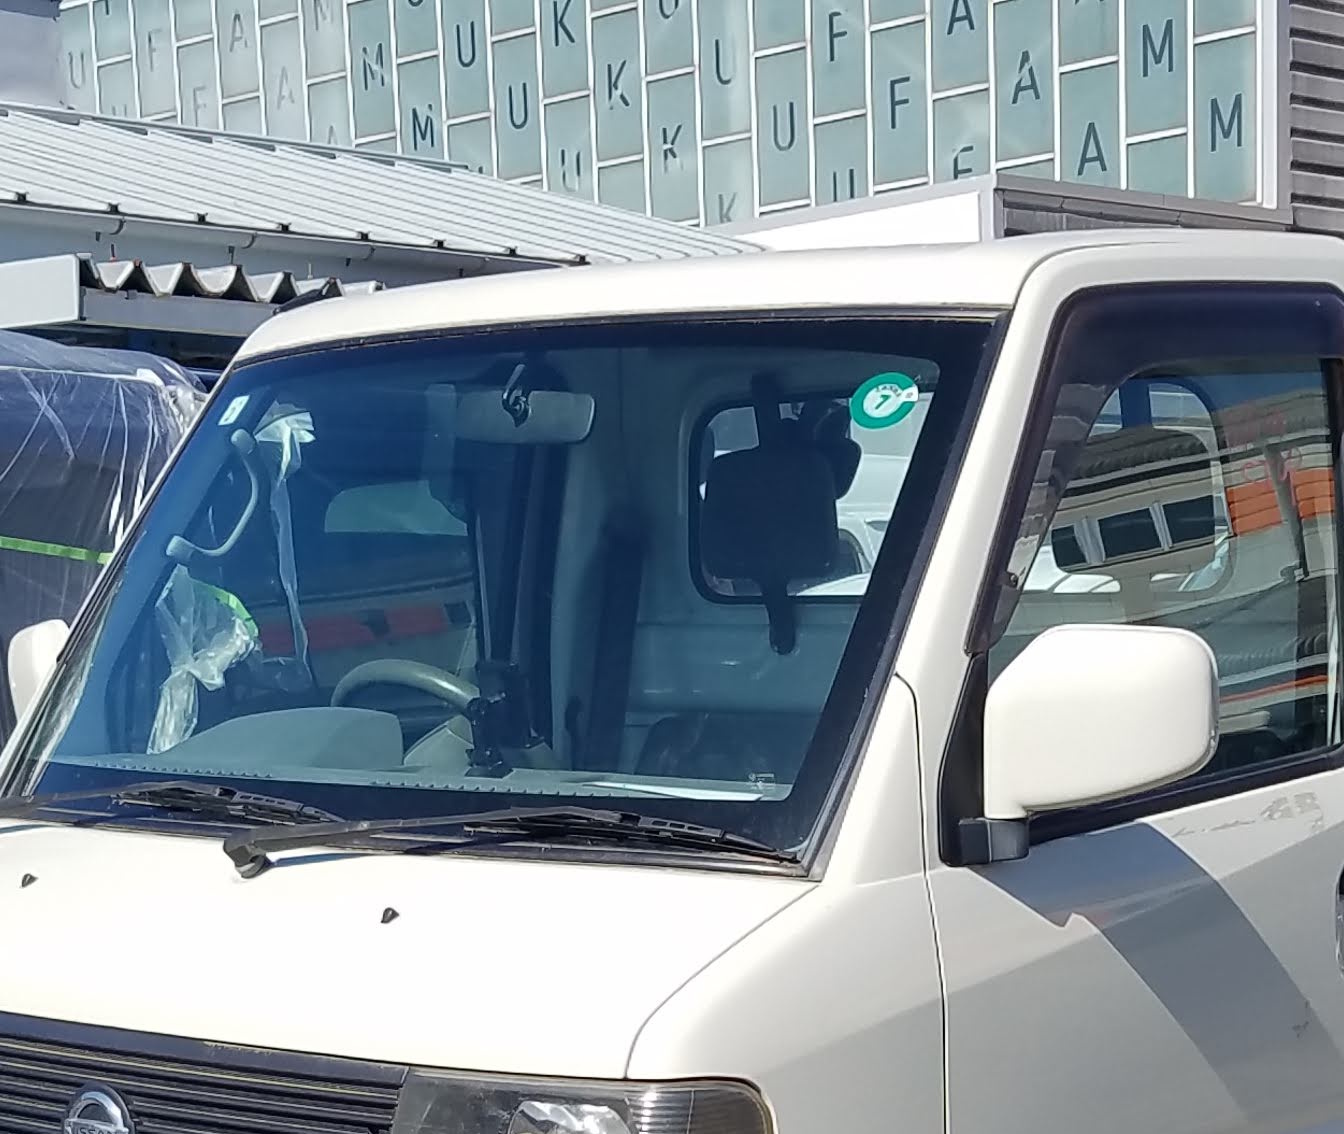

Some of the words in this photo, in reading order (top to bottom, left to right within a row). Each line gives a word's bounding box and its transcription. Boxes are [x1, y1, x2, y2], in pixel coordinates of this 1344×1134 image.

[228, 12, 248, 53] A
[362, 43, 385, 91] M
[456, 21, 477, 68] U
[554, 0, 576, 47] K
[411, 103, 435, 151] M
[508, 82, 528, 130] U
[607, 60, 631, 110] K
[829, 12, 848, 62] F
[947, 0, 975, 36] A
[773, 101, 796, 152] U
[889, 77, 911, 130] F
[1011, 50, 1041, 104] A
[1142, 19, 1174, 78] M
[1078, 122, 1109, 176] A
[1210, 93, 1243, 153] M
